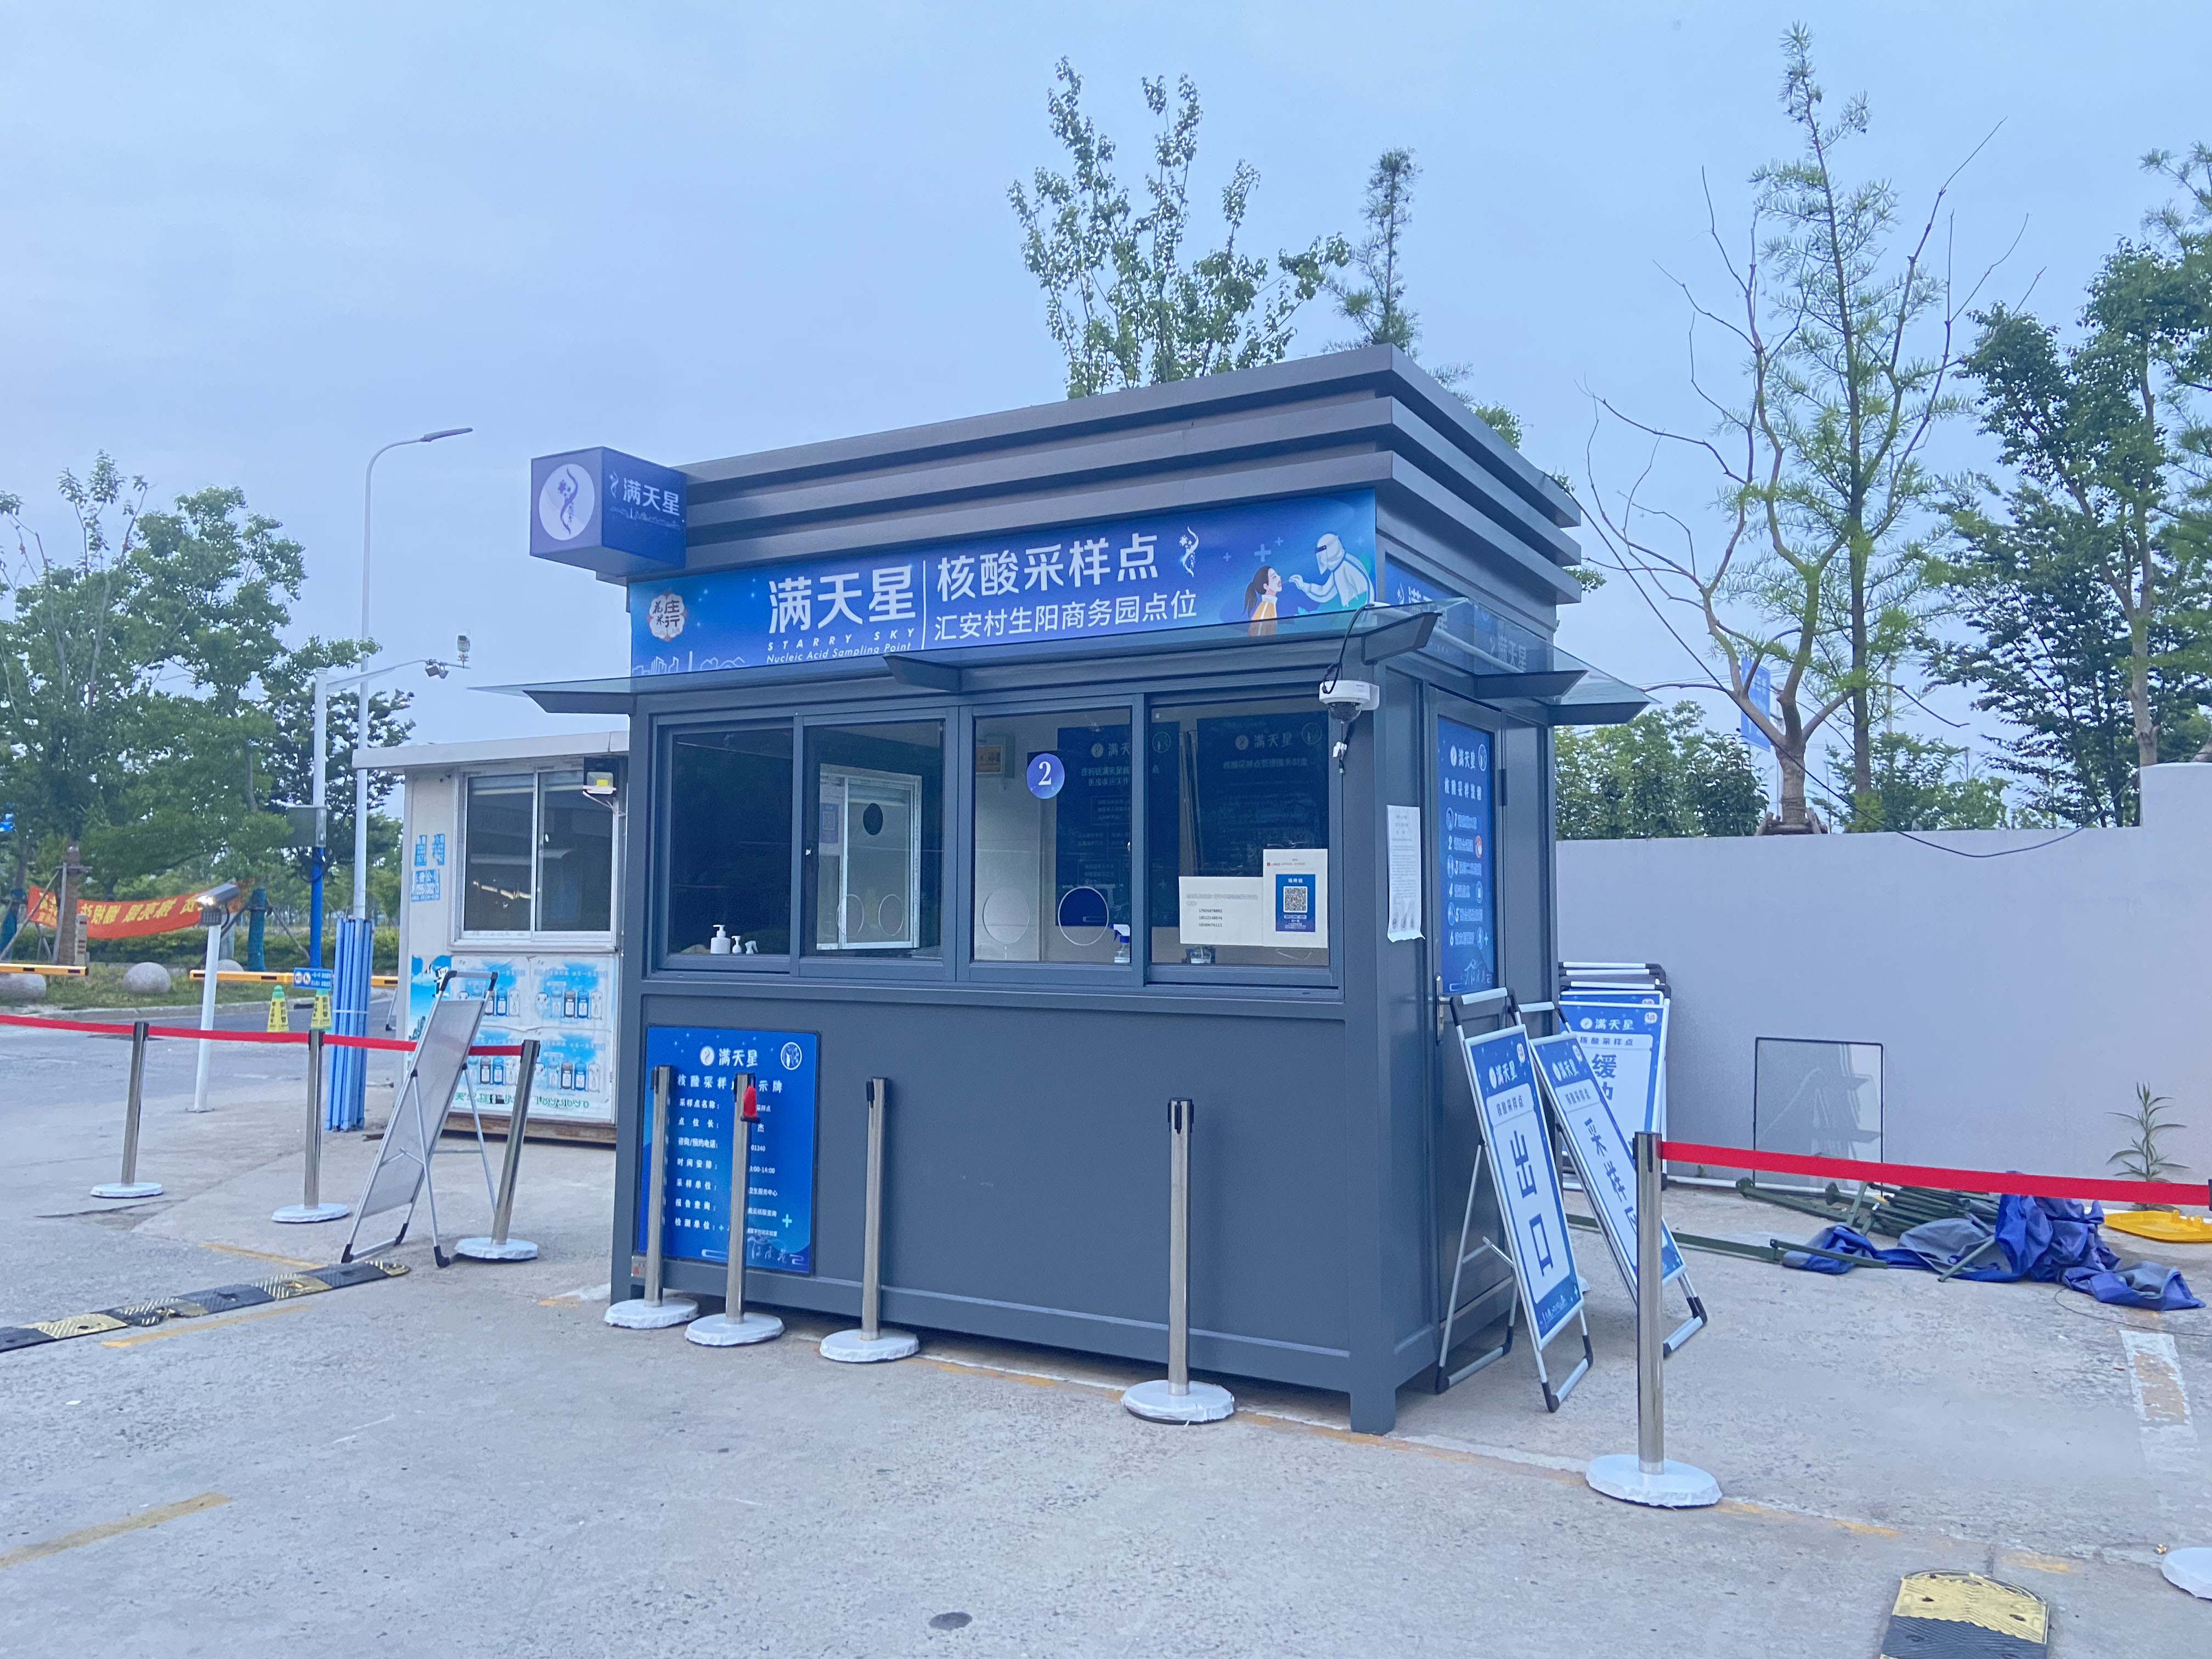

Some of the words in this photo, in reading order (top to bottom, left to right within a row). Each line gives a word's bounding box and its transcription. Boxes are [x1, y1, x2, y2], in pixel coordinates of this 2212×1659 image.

[623, 477, 680, 517] 满天星
[936, 532, 1159, 602] 核酸采样点
[769, 565, 916, 634] 满天星
[934, 589, 1198, 642] 汇安村生阳商务园点位
[768, 634, 852, 651] STARRY
[874, 628, 915, 641] SKY
[766, 652, 804, 664] Nucleic
[806, 648, 830, 660] Acid
[832, 645, 879, 658] Sampling
[884, 642, 911, 653] Point
[1254, 732, 1293, 748] 满天星
[1458, 748, 1476, 770] 满天星
[1039, 761, 1052, 786] 2
[1454, 812, 1458, 827] 1
[1448, 835, 1453, 850] 2
[1454, 860, 1459, 875] 3
[1448, 882, 1454, 898] 4
[1454, 907, 1460, 922] 5
[1449, 930, 1454, 946] 6
[1594, 1018, 1634, 1031] 满天星
[1579, 1036, 1633, 1046] 核酸采样点
[718, 1047, 758, 1068] 满天星
[1495, 1059, 1519, 1086] 满天星
[1556, 1058, 1581, 1079] 满天星
[1496, 1095, 1525, 1117] 核酸采样点
[1510, 1130, 1554, 1278] 出口
